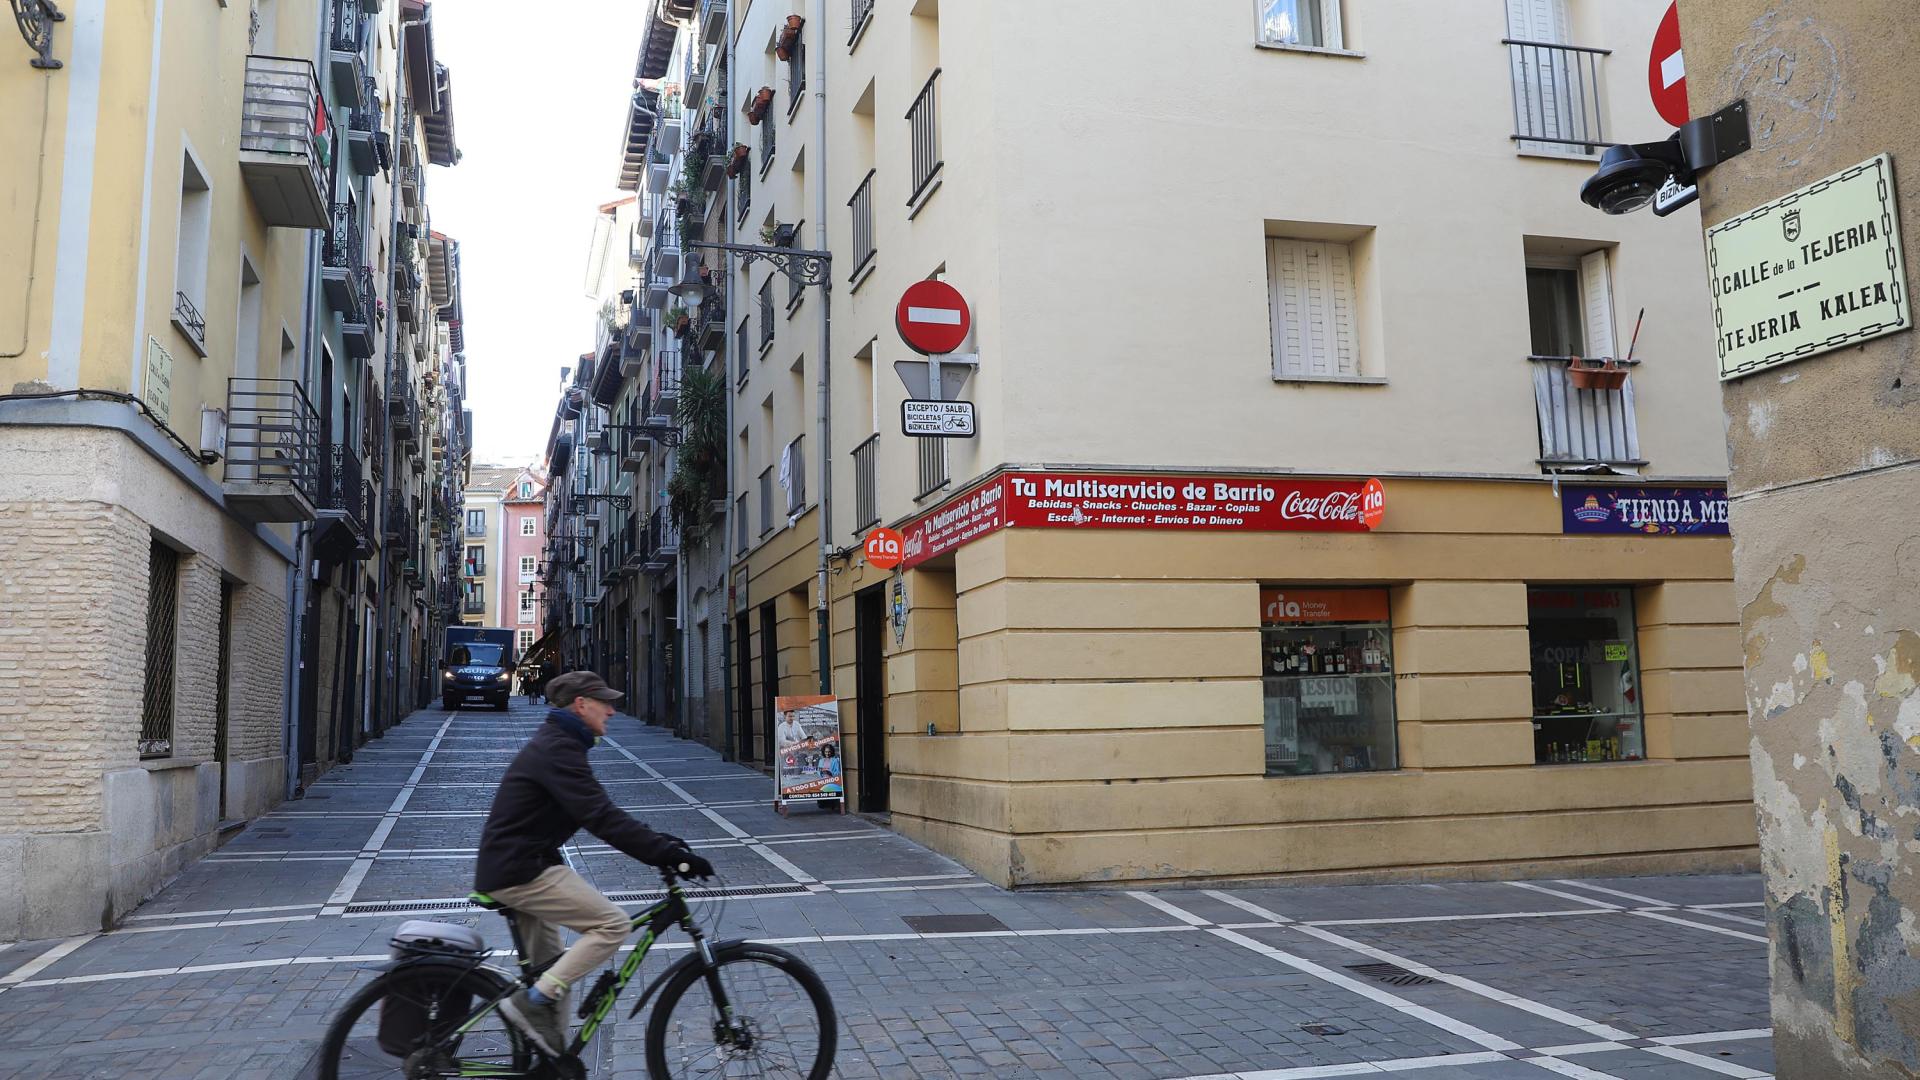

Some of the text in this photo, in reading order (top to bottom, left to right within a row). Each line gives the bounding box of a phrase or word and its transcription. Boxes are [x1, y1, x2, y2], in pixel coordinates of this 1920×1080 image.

[1722, 220, 1878, 295] CALLE de la TEJERIA
[1725, 281, 1888, 352] TEJERIA KALEA
[907, 403, 939, 413] EXCEPTO
[908, 423, 941, 431] BIZIKLETAK
[1011, 478, 1275, 502] Tu Multiservicio de Barrio
[1365, 485, 1382, 510] ria
[924, 483, 1002, 535] Tu Multiservicio de Barrio
[1028, 499, 1261, 514] Bebidas Snacks Chuches Bazar Copias
[1617, 498, 1728, 523] TIENDA ME
[1047, 512, 1093, 522] Escáer
[1101, 513, 1146, 523] Internet
[1192, 515, 1206, 525] De
[1209, 516, 1243, 525] Dinero
[868, 532, 899, 554] ria
[1267, 593, 1300, 618] ria
[1302, 601, 1327, 609] Money
[1302, 609, 1331, 617] Transfer
